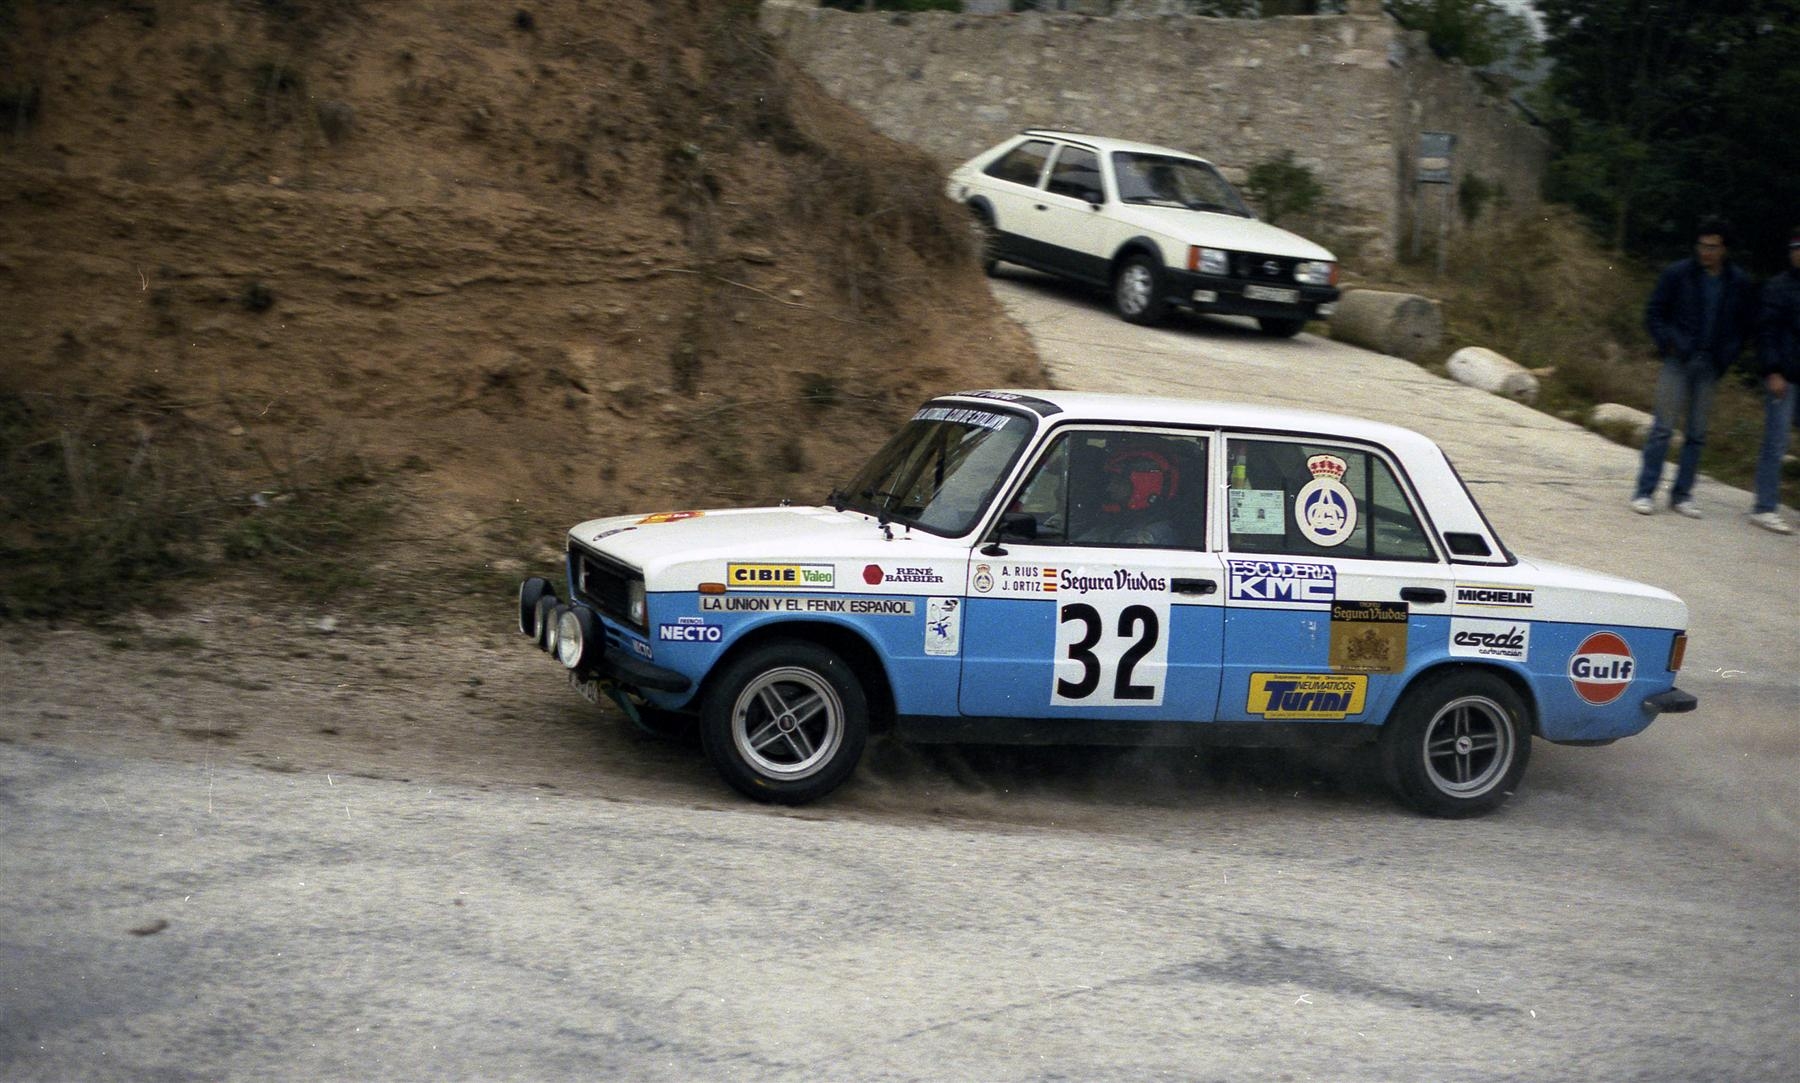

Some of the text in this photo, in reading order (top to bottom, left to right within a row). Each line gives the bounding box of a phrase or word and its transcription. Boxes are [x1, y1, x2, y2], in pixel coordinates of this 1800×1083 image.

[802, 570, 832, 582] Valeo
[896, 567, 933, 575] RENÉ
[1002, 566, 1039, 577] A. RIUS
[1231, 560, 1334, 579] ESCUDERIA
[885, 575, 943, 583] BARBIER
[1002, 581, 1041, 592] J. ORTIZ
[1060, 568, 1166, 594] Segura Viudas
[1232, 576, 1334, 599] KMC
[1458, 590, 1532, 604] MICHELIN
[704, 598, 911, 613] LA UNION Y EL FENIX ESPAÑOL
[1333, 607, 1407, 621] Segura Viudas
[660, 626, 721, 641] NECTO
[1454, 627, 1525, 649] esedé
[1057, 603, 1159, 699] 32
[1571, 657, 1632, 679] Gulf
[1295, 682, 1356, 690] NEUMATICOS
[1264, 681, 1352, 711] Turini
